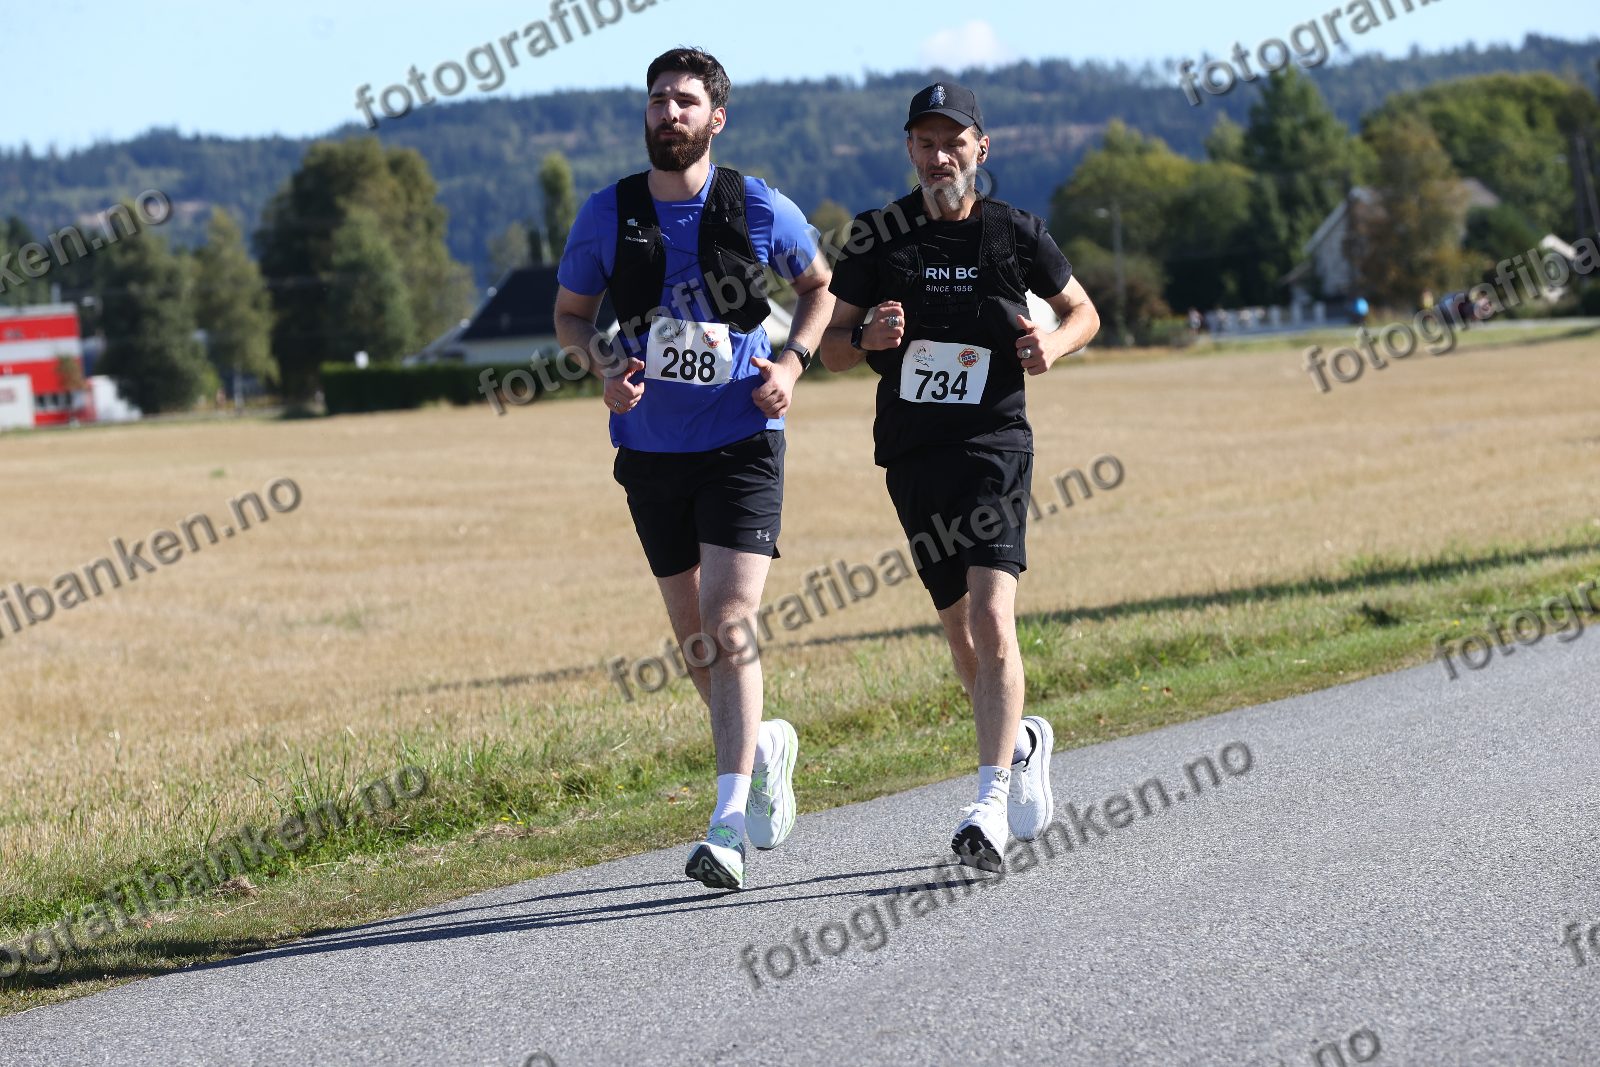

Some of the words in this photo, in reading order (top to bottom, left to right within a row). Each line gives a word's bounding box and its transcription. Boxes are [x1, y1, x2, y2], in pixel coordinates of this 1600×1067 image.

[925, 284, 950, 293] SINCE
[661, 346, 716, 383] 288
[914, 368, 968, 401] 734
